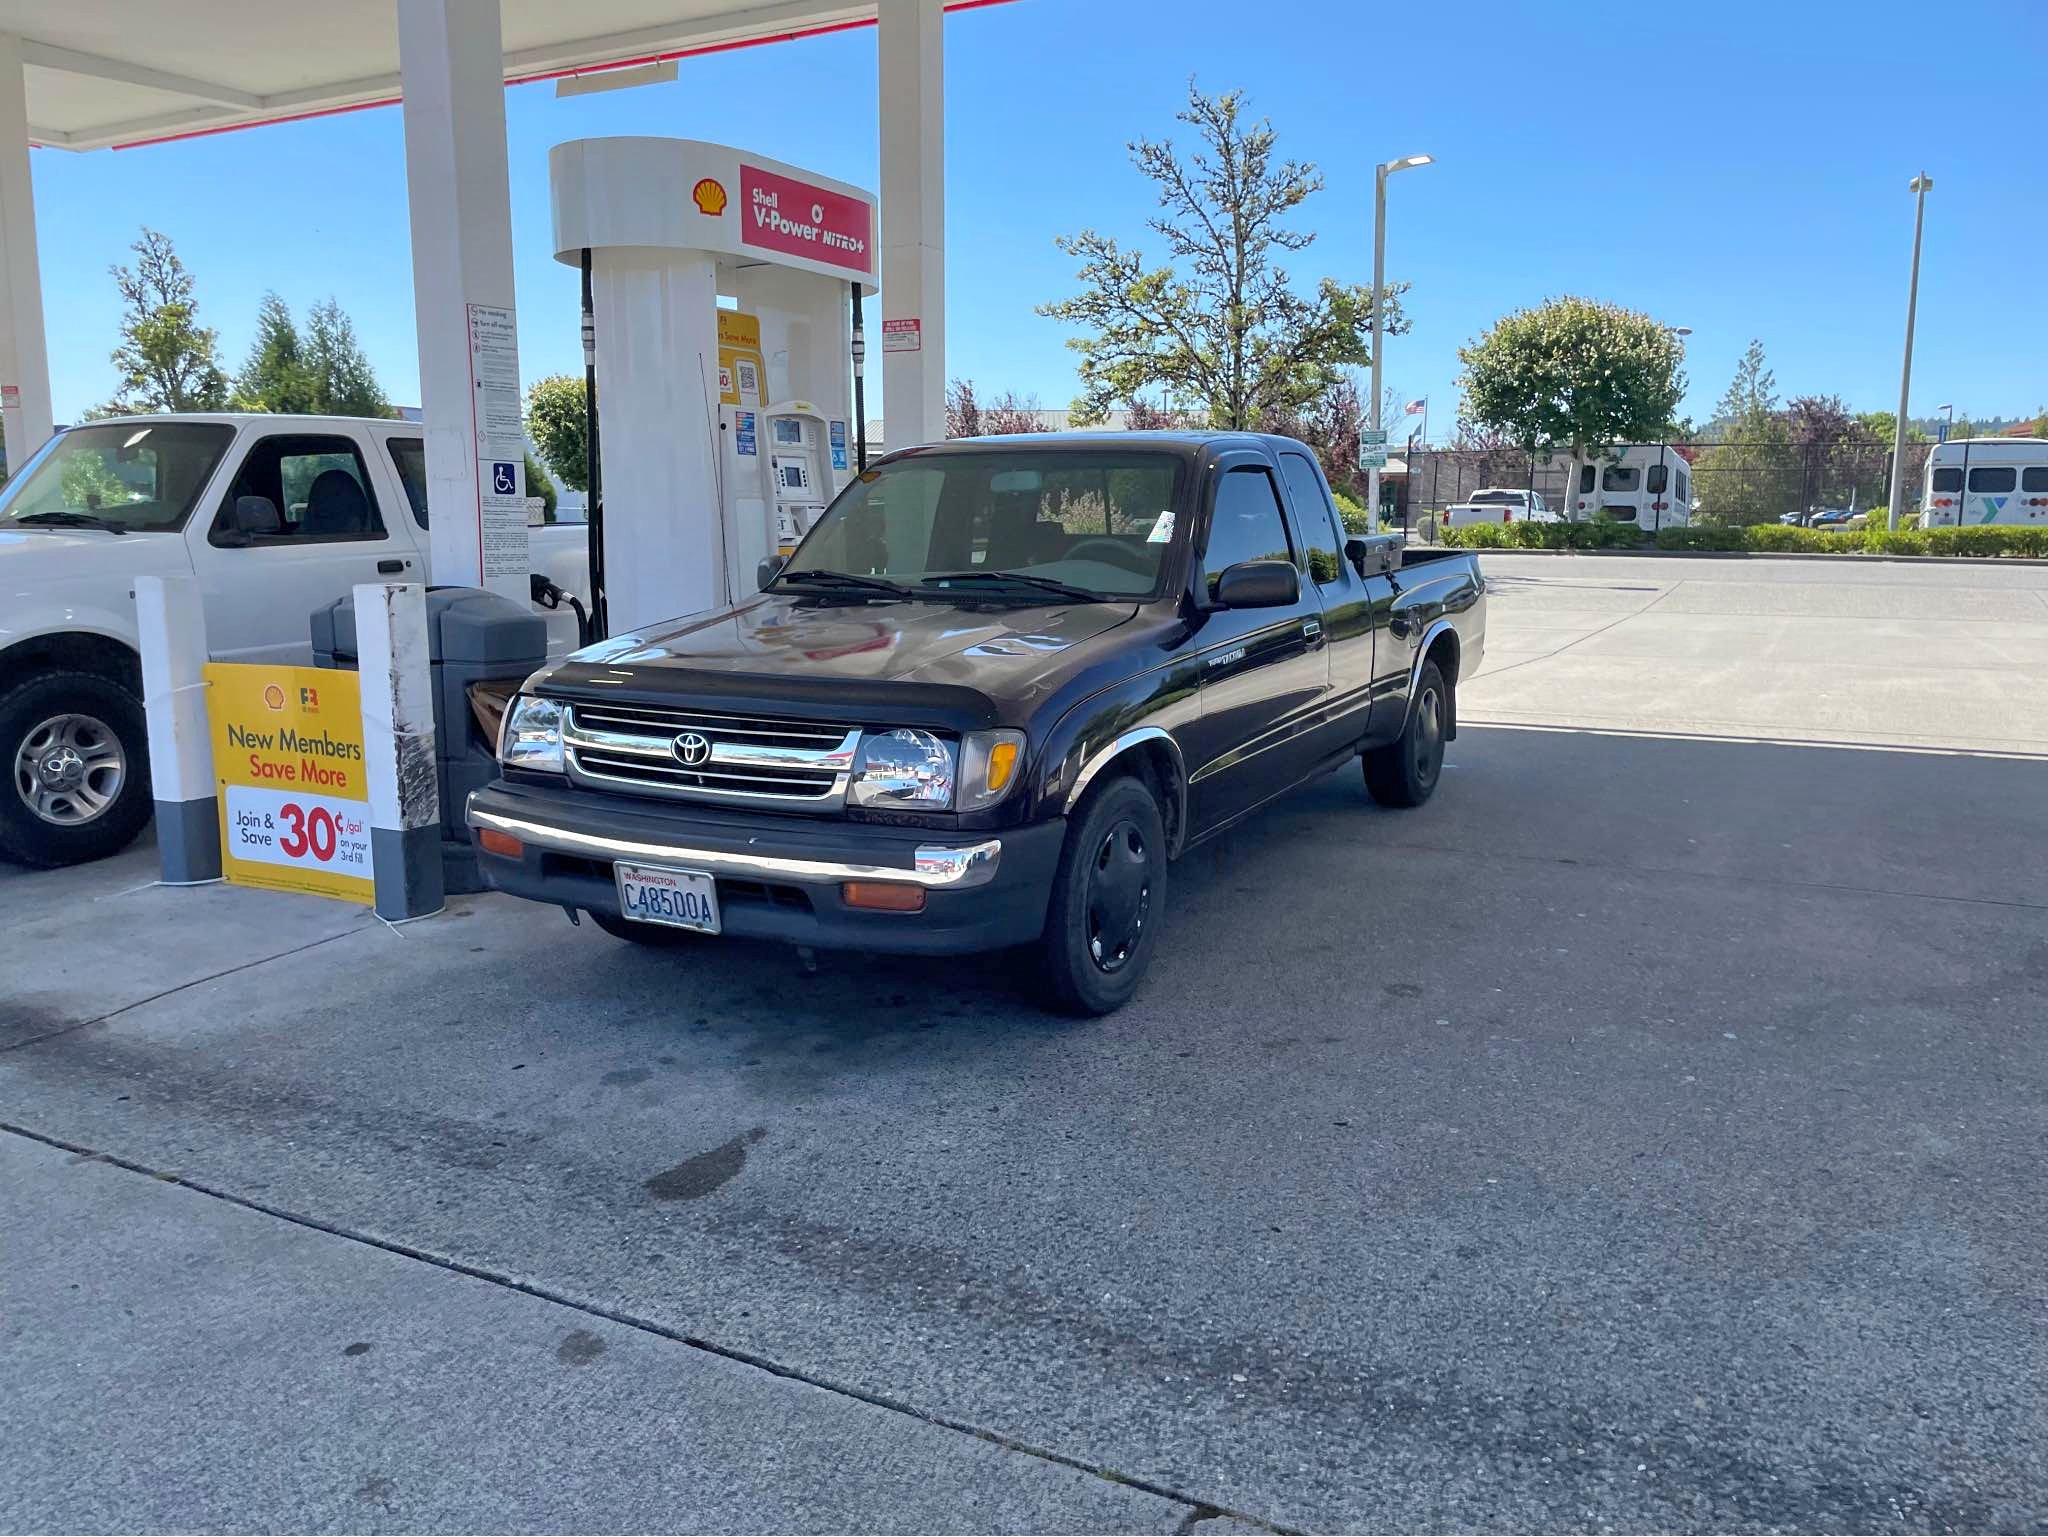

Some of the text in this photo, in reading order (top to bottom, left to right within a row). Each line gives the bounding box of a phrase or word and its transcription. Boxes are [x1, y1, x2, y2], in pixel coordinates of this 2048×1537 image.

[752, 187, 778, 209] Shell
[753, 205, 818, 241] V-Power
[227, 722, 362, 761] New Members
[249, 753, 347, 788] Save More
[235, 809, 275, 830] Join &
[240, 827, 273, 847] Save
[340, 838, 367, 852] on your
[340, 850, 364, 865] 3rd fill
[623, 872, 677, 887] WASHINGTON
[623, 882, 713, 924] C48500A
